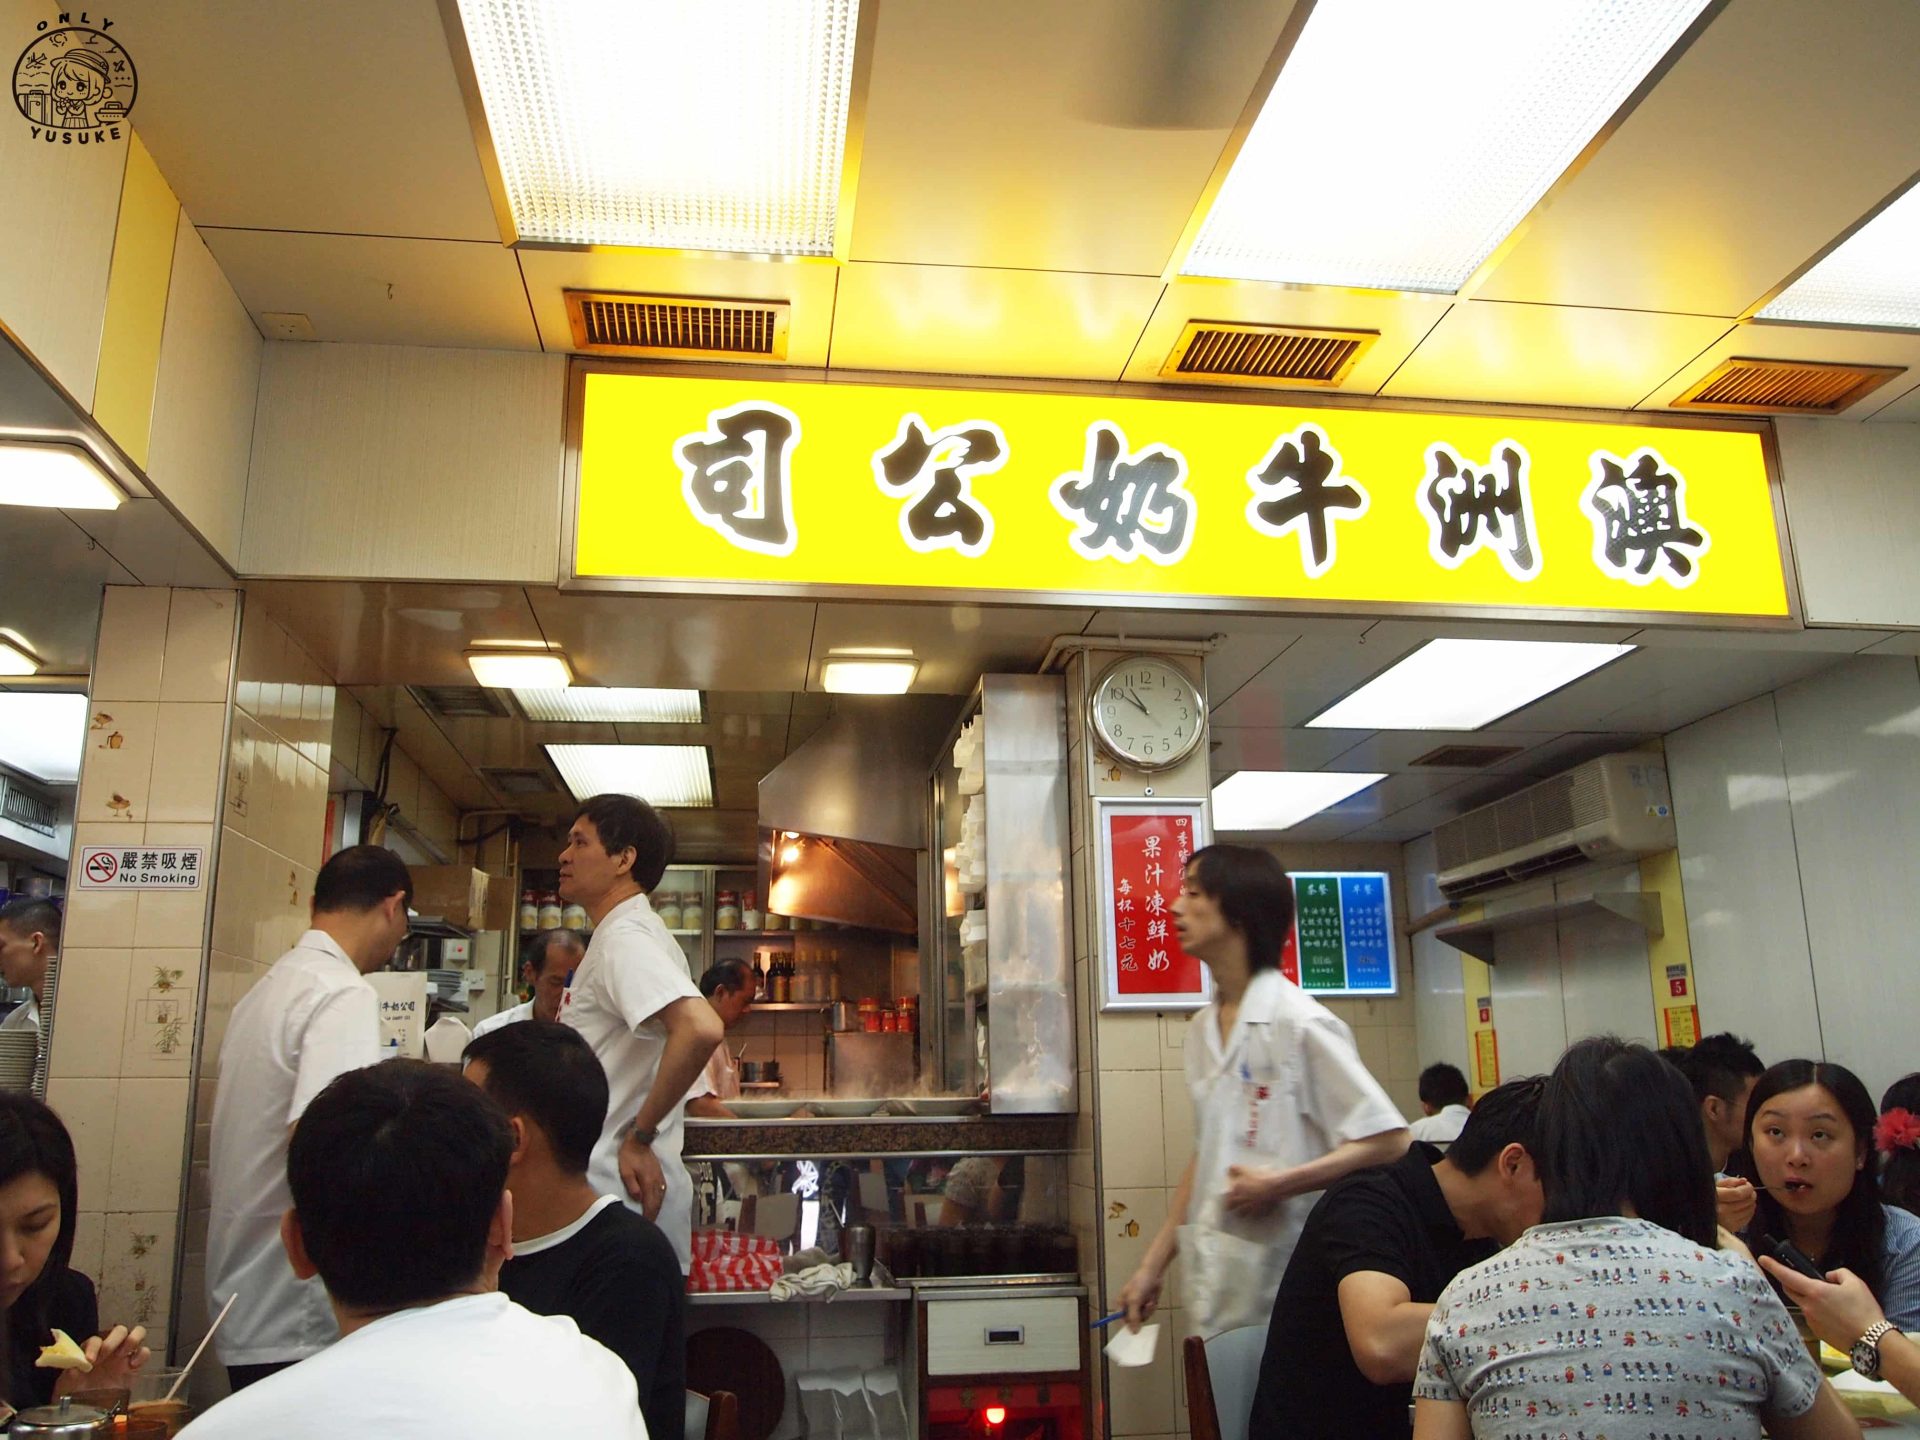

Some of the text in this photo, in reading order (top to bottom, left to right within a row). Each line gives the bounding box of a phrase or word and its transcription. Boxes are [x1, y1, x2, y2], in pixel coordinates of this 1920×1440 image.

[1125, 674, 1133, 687] 11
[1141, 671, 1152, 684] 12
[1111, 688, 1124, 700] 10
[1174, 689, 1182, 701] 2
[1107, 705, 1116, 717] 9
[1180, 707, 1188, 720] 3
[1114, 724, 1122, 737] 8
[1174, 726, 1182, 739] 4
[1127, 738, 1135, 751] 7
[1144, 742, 1153, 755] 6
[1162, 738, 1170, 751] 5
[120, 852, 198, 870] 嚴禁吸煙
[119, 873, 196, 885] No Smoking
[1117, 878, 1139, 972] 每杯十七元
[1675, 981, 1682, 994] 5
[380, 1001, 415, 1012] 牛奶公司
